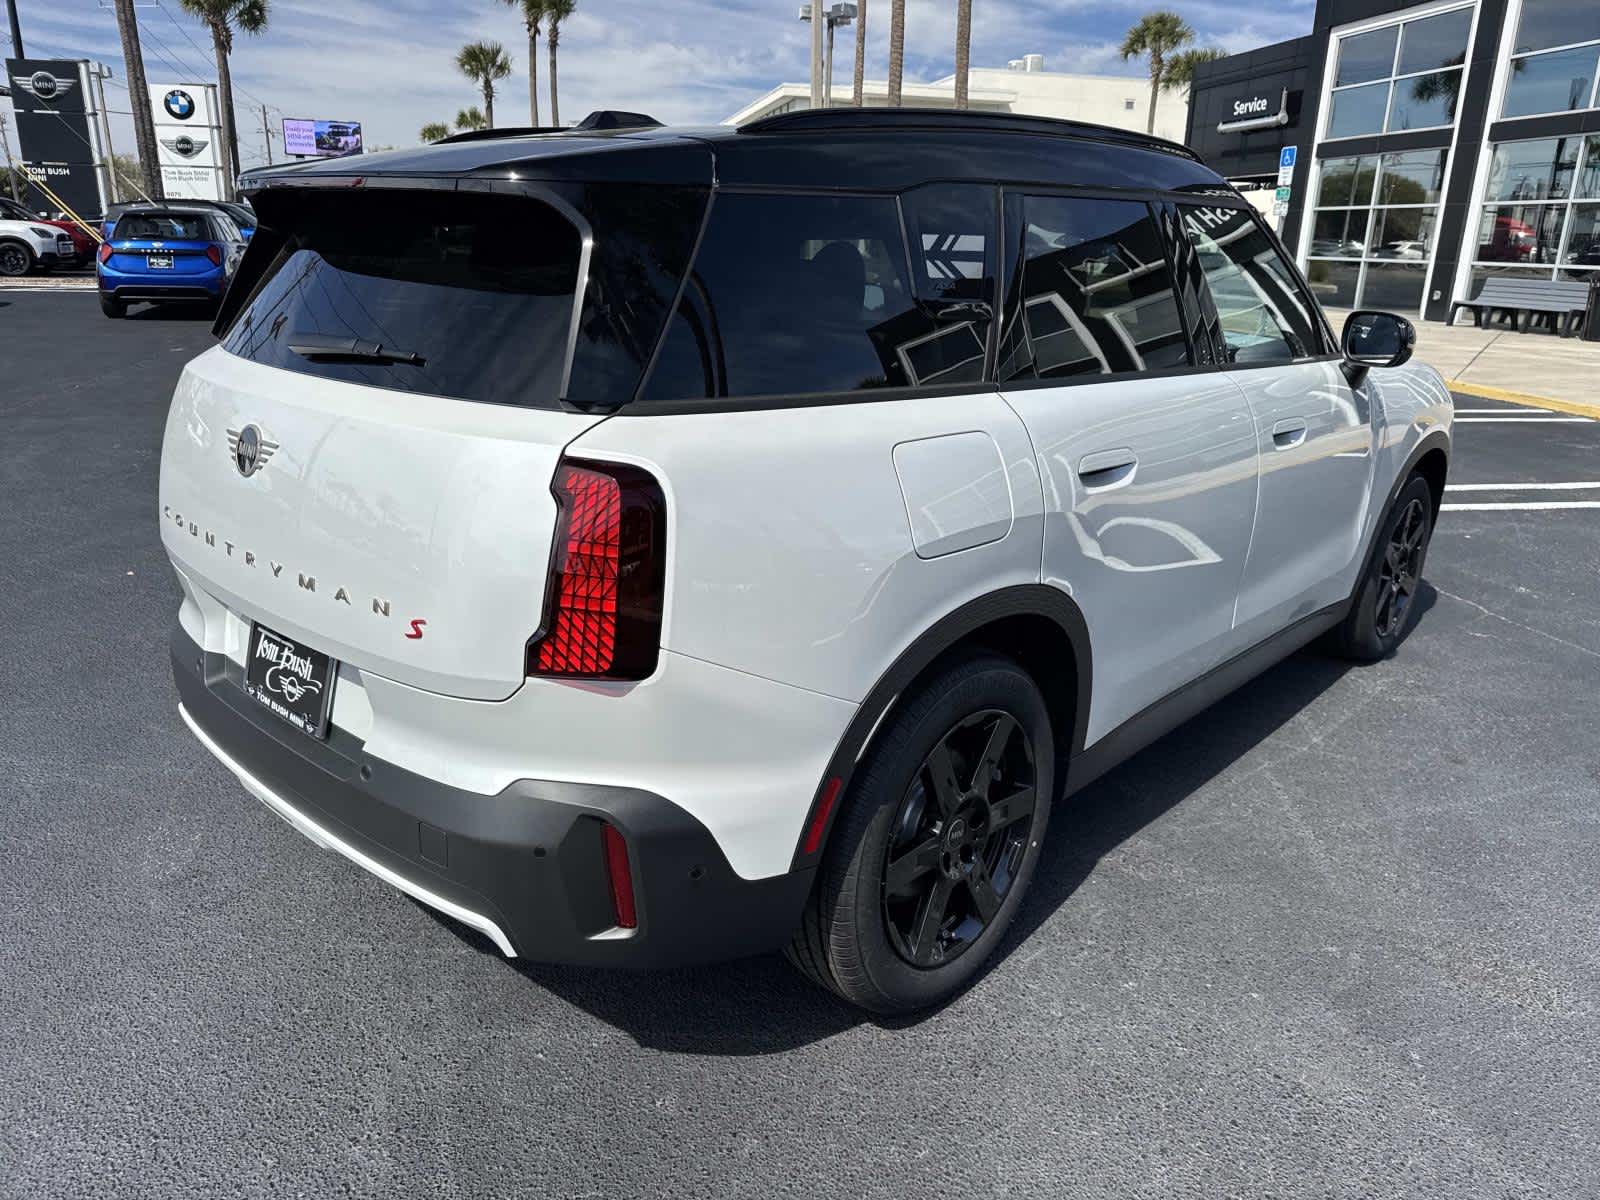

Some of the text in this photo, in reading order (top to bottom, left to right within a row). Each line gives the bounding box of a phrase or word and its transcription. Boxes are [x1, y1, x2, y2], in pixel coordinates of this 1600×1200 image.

[34, 80, 55, 90] MINI
[1233, 97, 1268, 116] Service
[26, 167, 70, 176] TOM BUSH
[238, 440, 257, 459] MINI
[163, 504, 427, 640] COUNTRYMAN S
[256, 691, 305, 729] TOM BUSH MINI
